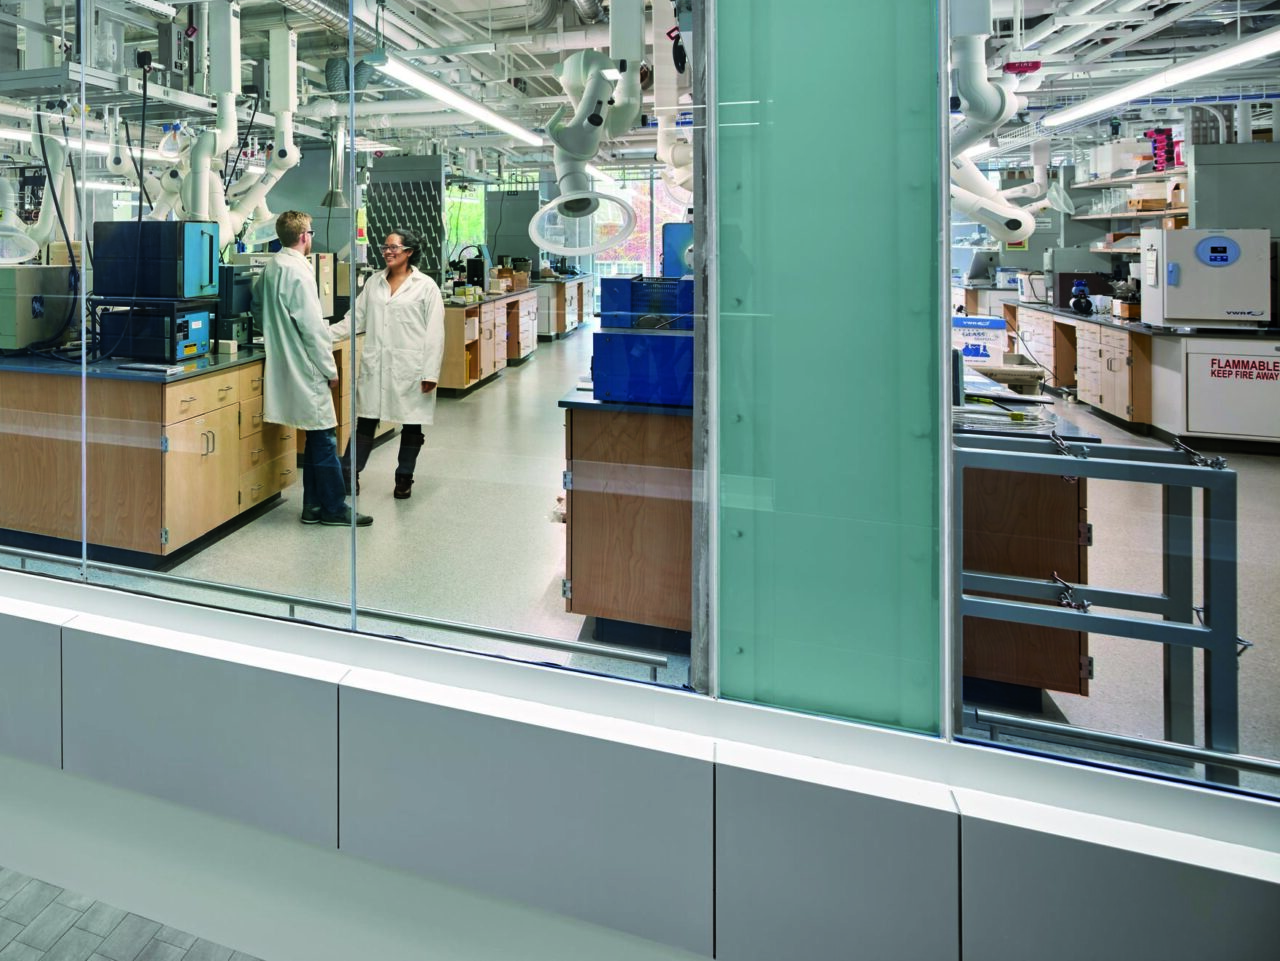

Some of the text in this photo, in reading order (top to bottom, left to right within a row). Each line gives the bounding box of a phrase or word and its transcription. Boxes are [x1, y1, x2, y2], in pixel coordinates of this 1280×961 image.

[1210, 358, 1280, 372] FLAMMABLE
[1210, 369, 1280, 381] KEEP FIRE AWAY
